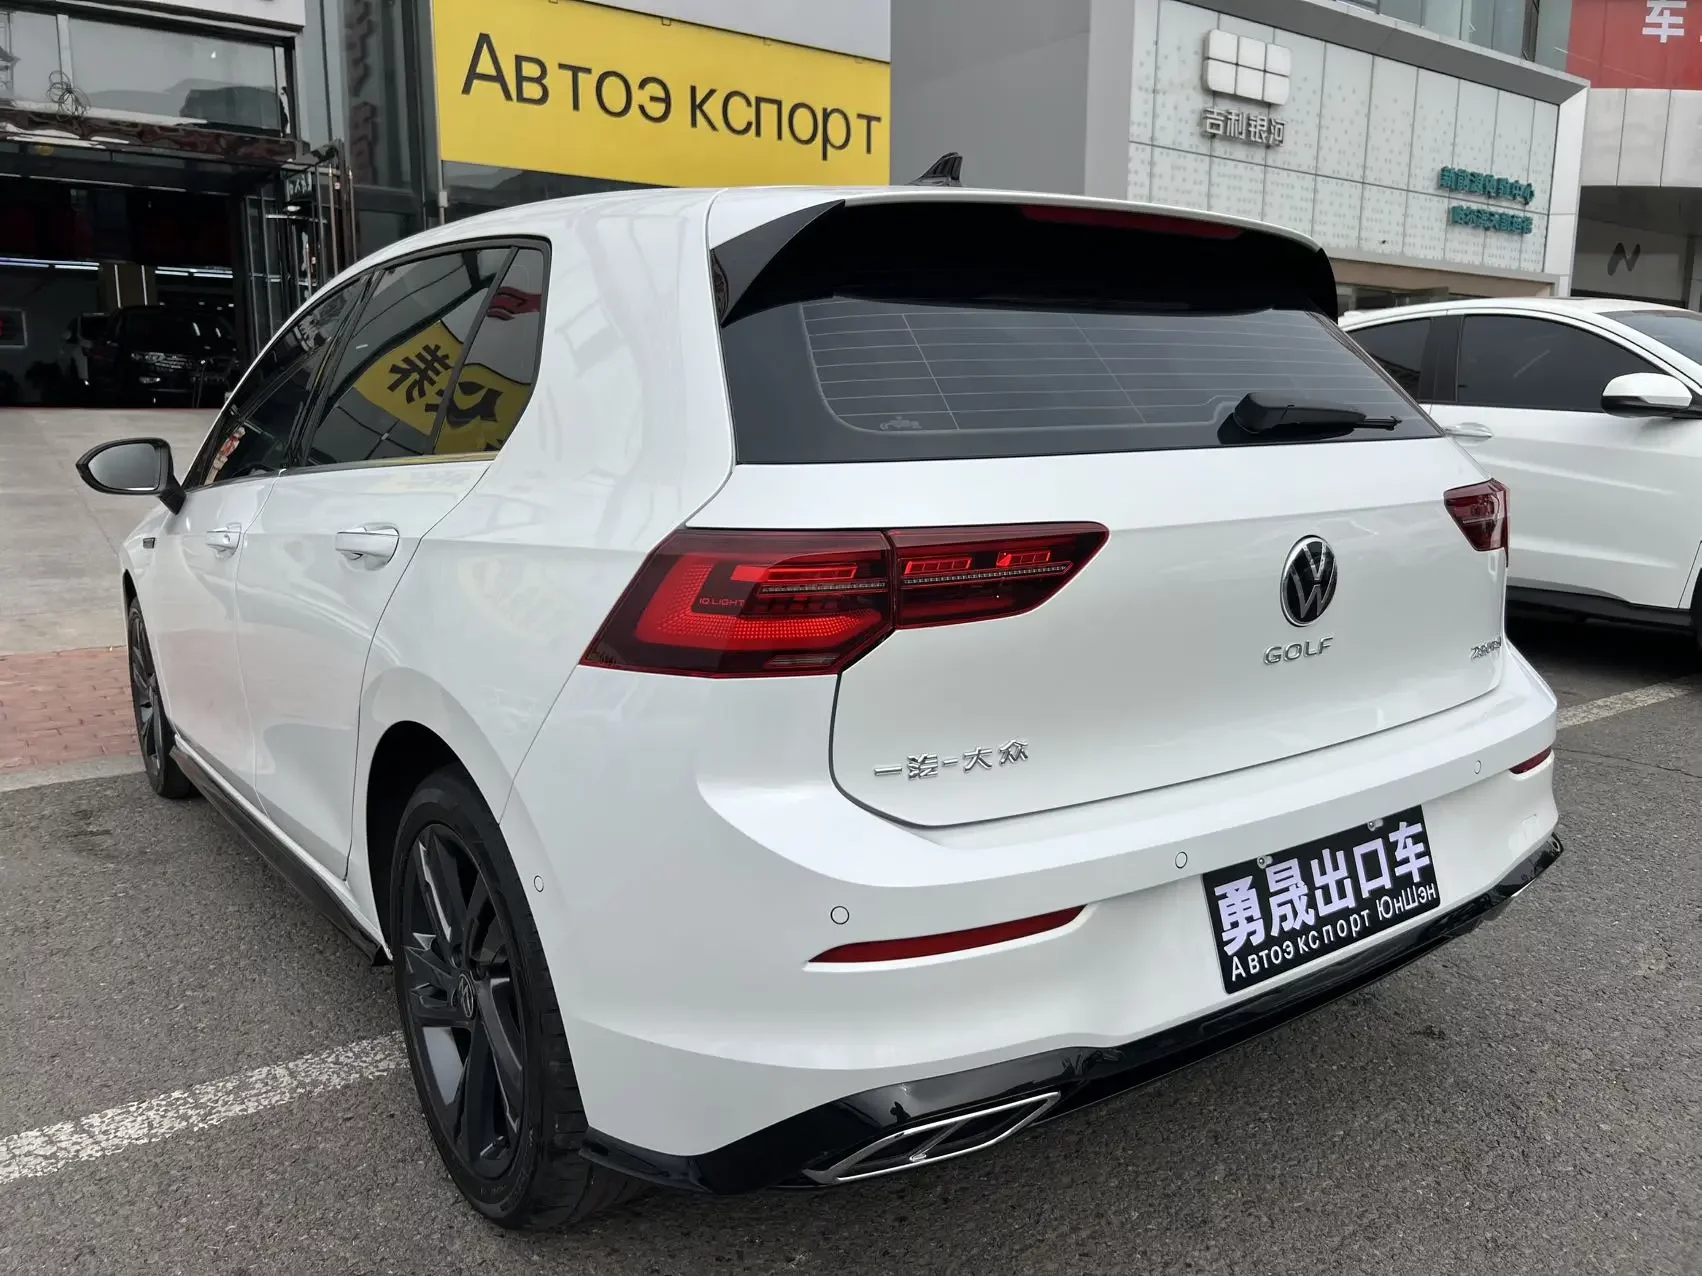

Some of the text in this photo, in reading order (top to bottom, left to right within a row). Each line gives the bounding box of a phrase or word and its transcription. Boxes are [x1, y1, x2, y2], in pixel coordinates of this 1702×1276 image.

[1642, 0, 1687, 43] 车
[1202, 107, 1288, 145] 吉利银河
[1263, 635, 1334, 665] GOLF
[1214, 821, 1431, 956] 勇晟出口车
